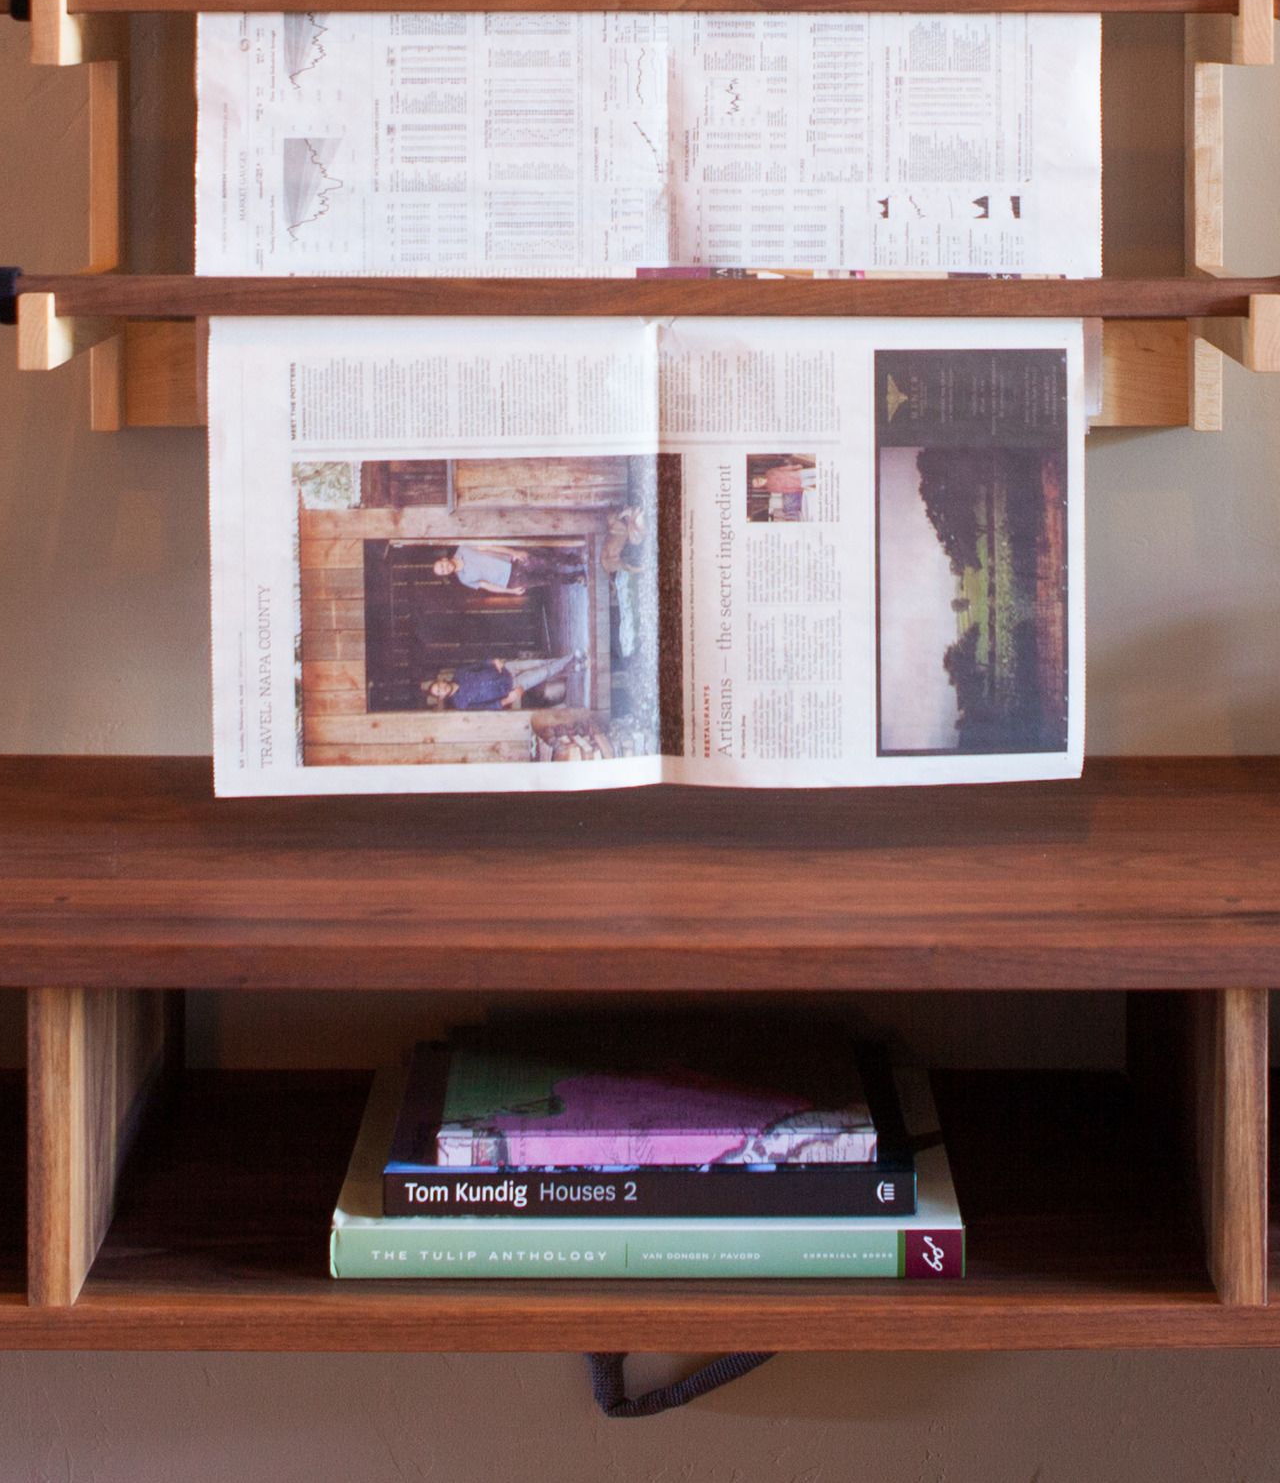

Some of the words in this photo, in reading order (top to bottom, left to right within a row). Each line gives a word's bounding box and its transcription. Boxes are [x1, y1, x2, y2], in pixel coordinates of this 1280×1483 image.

[715, 465, 735, 560] ingredient
[257, 584, 272, 650] COUNTY
[718, 564, 732, 618] secret
[716, 622, 732, 652] the
[259, 652, 272, 698] NAPA
[260, 701, 273, 769] TRAVEL:
[703, 684, 711, 759] RESTAURANTS
[717, 677, 733, 759] Artisans
[404, 1182, 449, 1202] Tom
[455, 1180, 527, 1207] Kundig
[540, 1181, 616, 1202] Houses
[623, 1181, 638, 1202] 2
[371, 1250, 408, 1261] THE
[419, 1250, 478, 1261] TULIP
[488, 1250, 609, 1261] ANTHOLOGY
[641, 1252, 663, 1260] VAN
[666, 1252, 709, 1260] DONGEN
[720, 1252, 761, 1260] PAVORD
